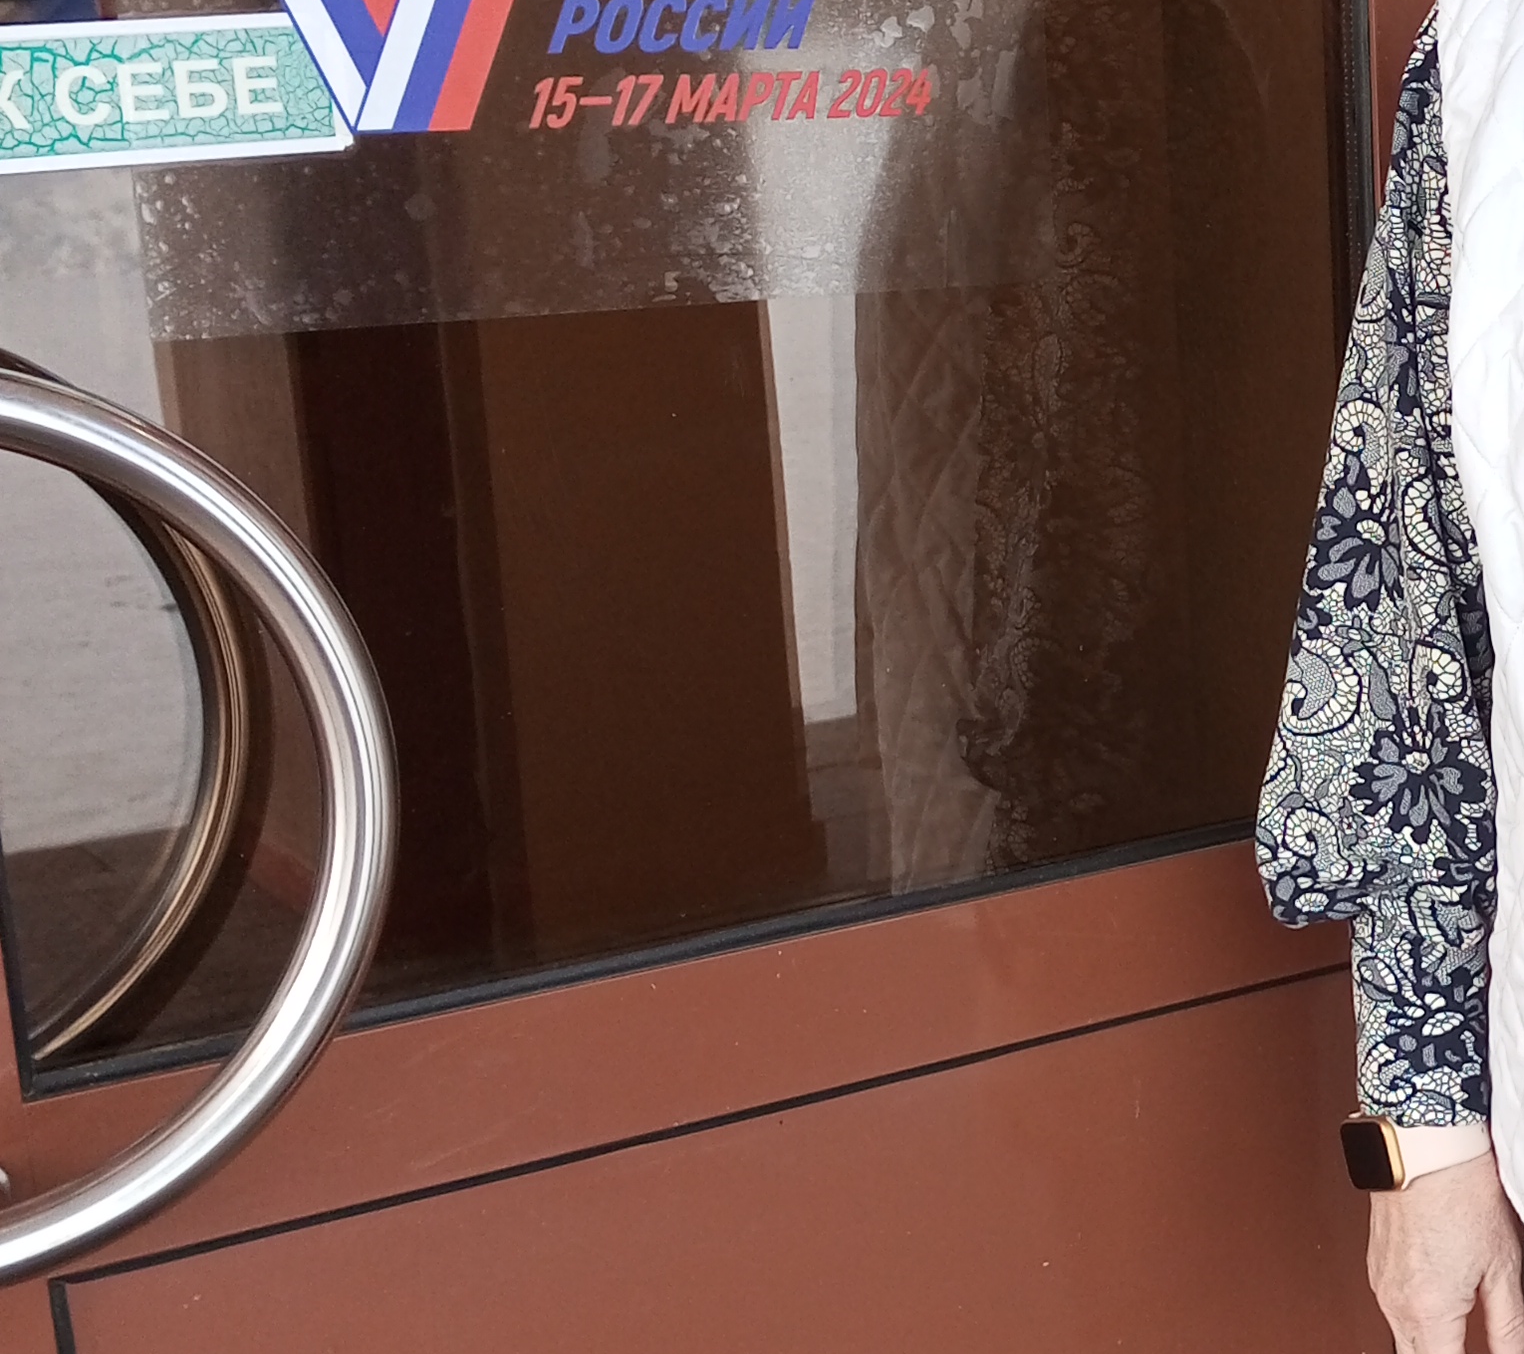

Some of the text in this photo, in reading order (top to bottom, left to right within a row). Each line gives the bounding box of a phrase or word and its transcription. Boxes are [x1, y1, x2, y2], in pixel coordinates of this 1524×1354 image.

[55, 56, 284, 127] СЕБЕ
[665, 70, 822, 124] МАРТА
[827, 68, 931, 119] 2024
